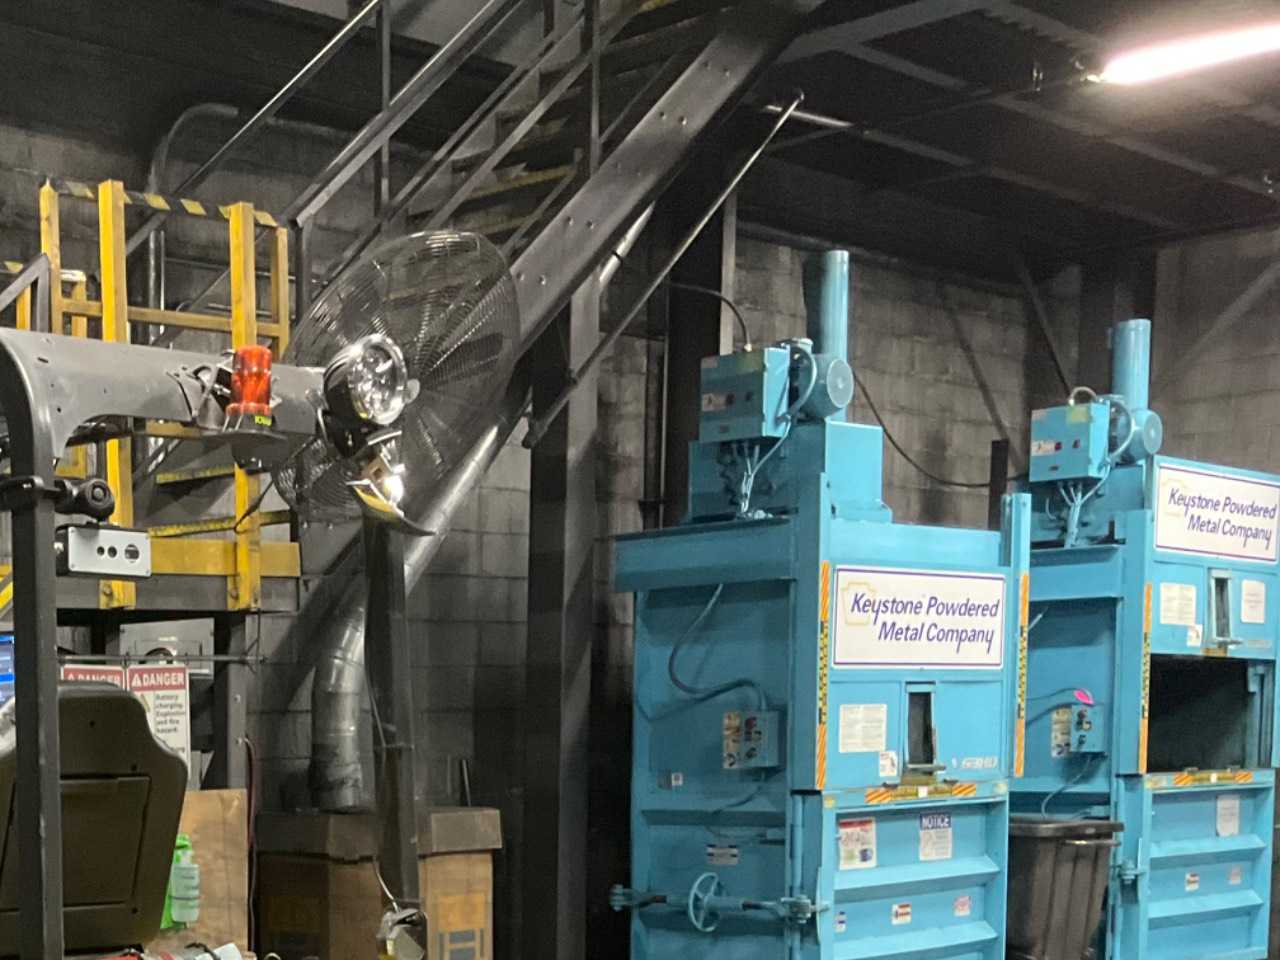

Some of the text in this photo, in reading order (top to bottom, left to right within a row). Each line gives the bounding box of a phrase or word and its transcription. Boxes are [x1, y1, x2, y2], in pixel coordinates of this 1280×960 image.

[1168, 488, 1278, 520] Keystone Powdered
[1187, 514, 1272, 550] Metal Company
[850, 592, 1000, 625] Keystone Powdered
[878, 621, 995, 654] Metal Company
[142, 672, 185, 687] DANGER
[922, 814, 950, 828] NOTICE
